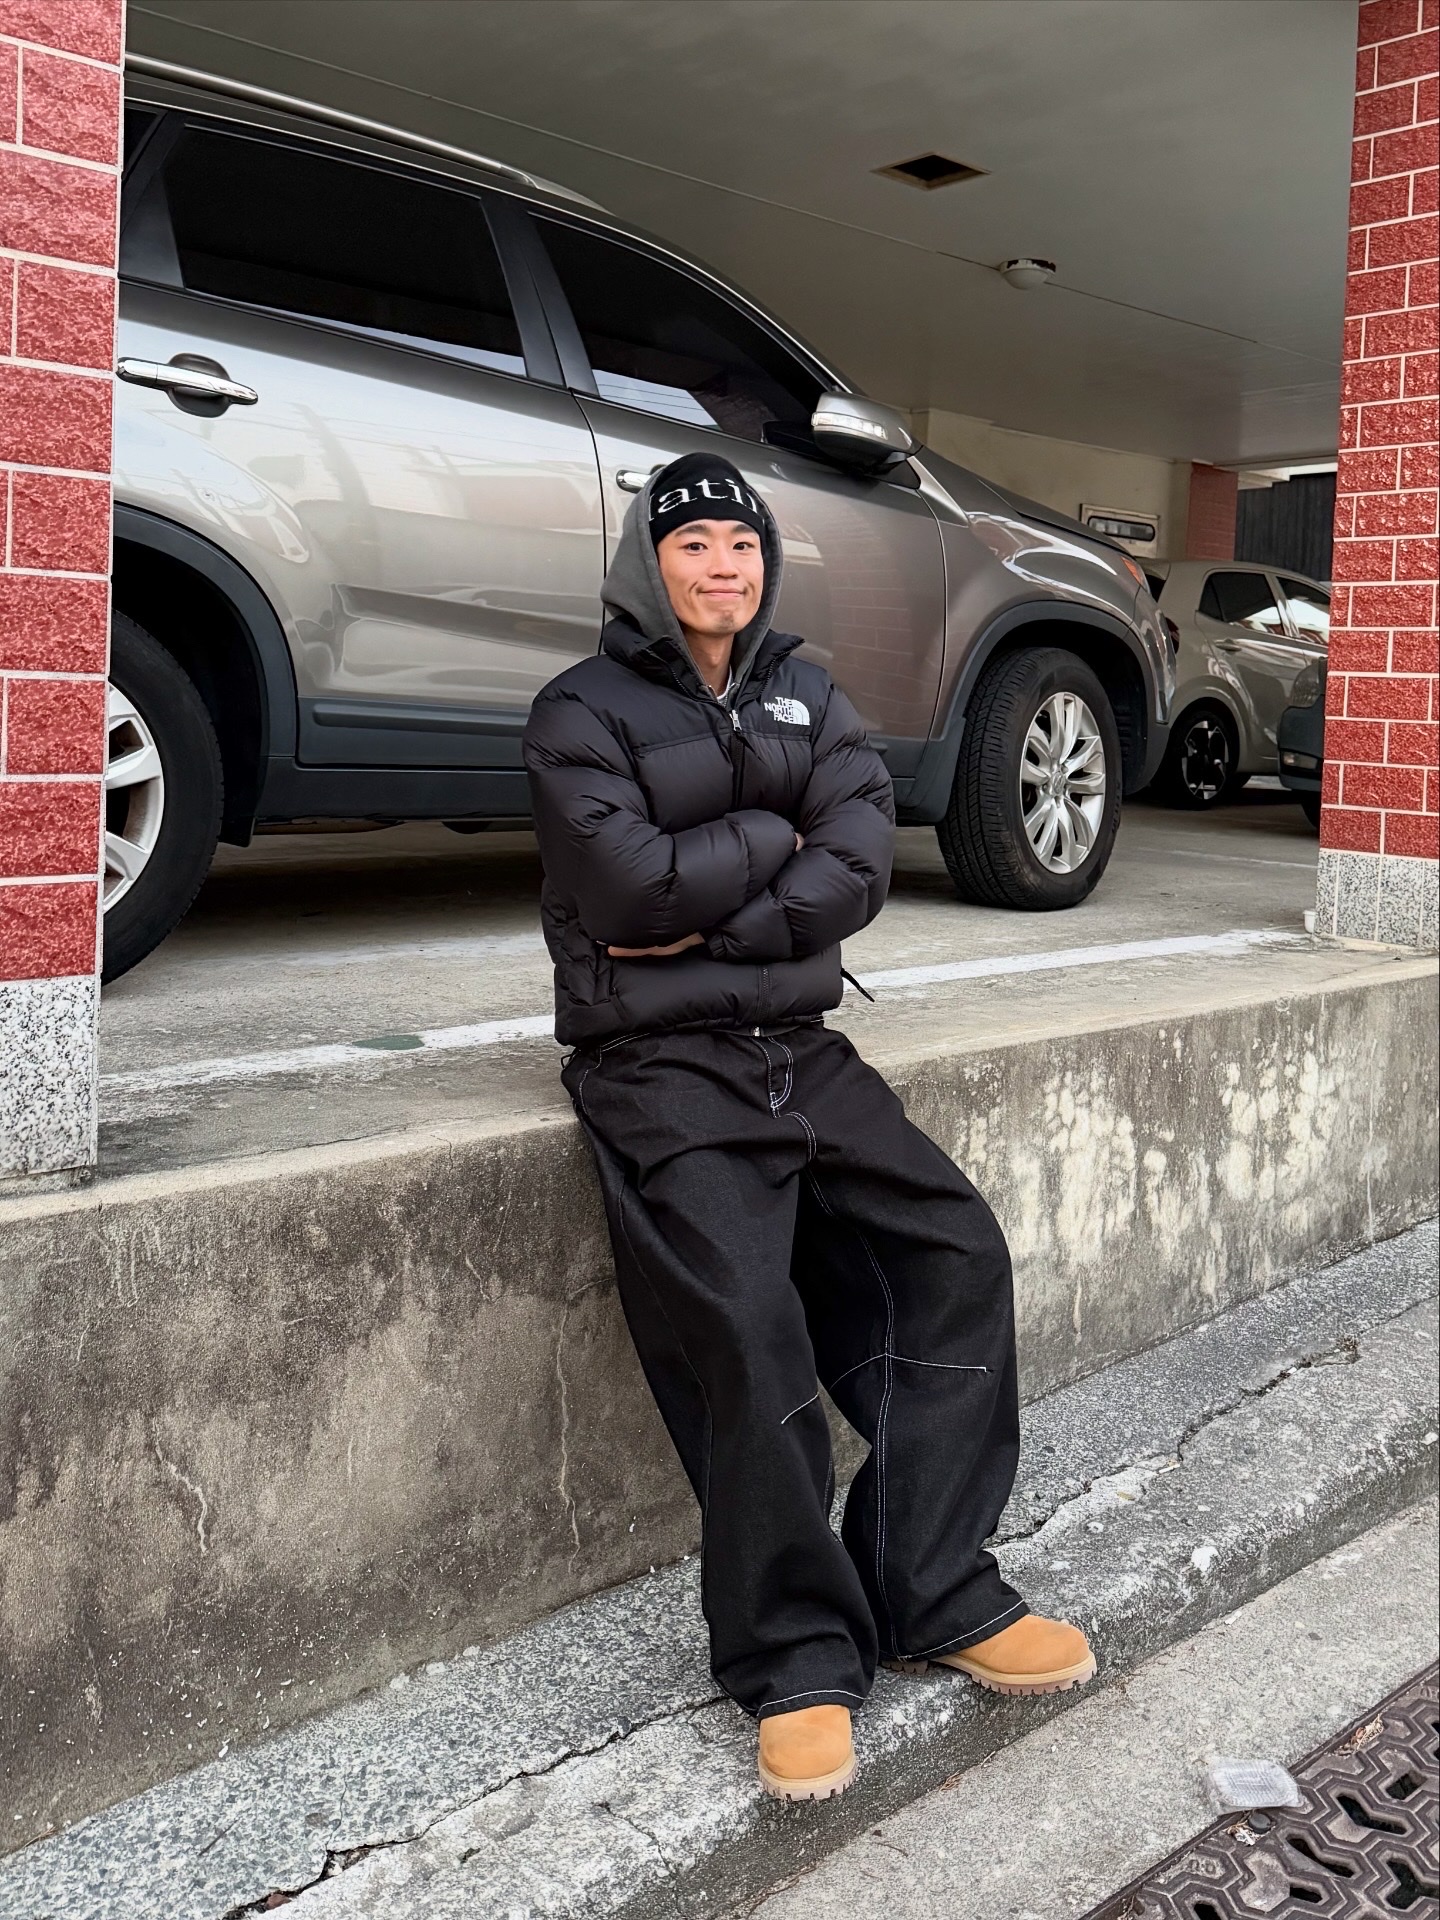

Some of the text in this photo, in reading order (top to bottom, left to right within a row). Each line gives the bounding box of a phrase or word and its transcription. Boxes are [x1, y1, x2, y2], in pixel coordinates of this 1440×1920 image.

[775, 696, 793, 707] THE
[764, 702, 793, 716] NORTH
[774, 713, 794, 723] FACE
